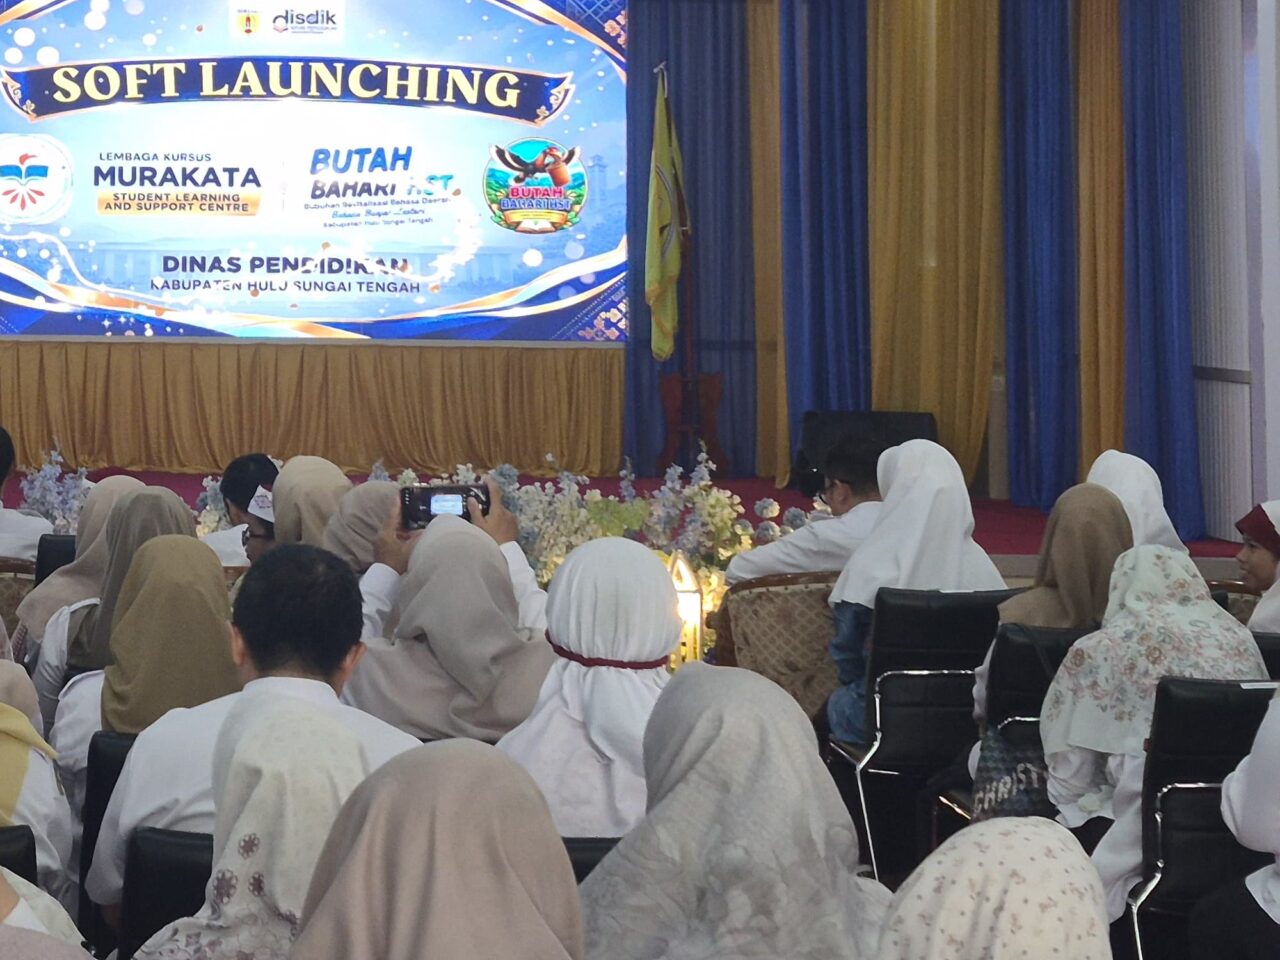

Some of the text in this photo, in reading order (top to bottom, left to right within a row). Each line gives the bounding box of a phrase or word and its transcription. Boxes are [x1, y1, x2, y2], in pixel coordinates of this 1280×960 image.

[272, 9, 336, 25] disdik
[53, 61, 520, 108] SOFT LAUNCHING
[99, 152, 212, 162] LEMBAGA KURSUS
[310, 145, 413, 175] BUTAH
[93, 165, 262, 188] MURAKATA
[113, 192, 240, 203] STUDENT LEARNING
[509, 186, 564, 199] BUTAH
[104, 202, 249, 213] AND SUPPORT CENTRE
[162, 255, 242, 274] DINAS
[293, 280, 352, 293] SUNGAI
[356, 281, 420, 294] TENGAH
